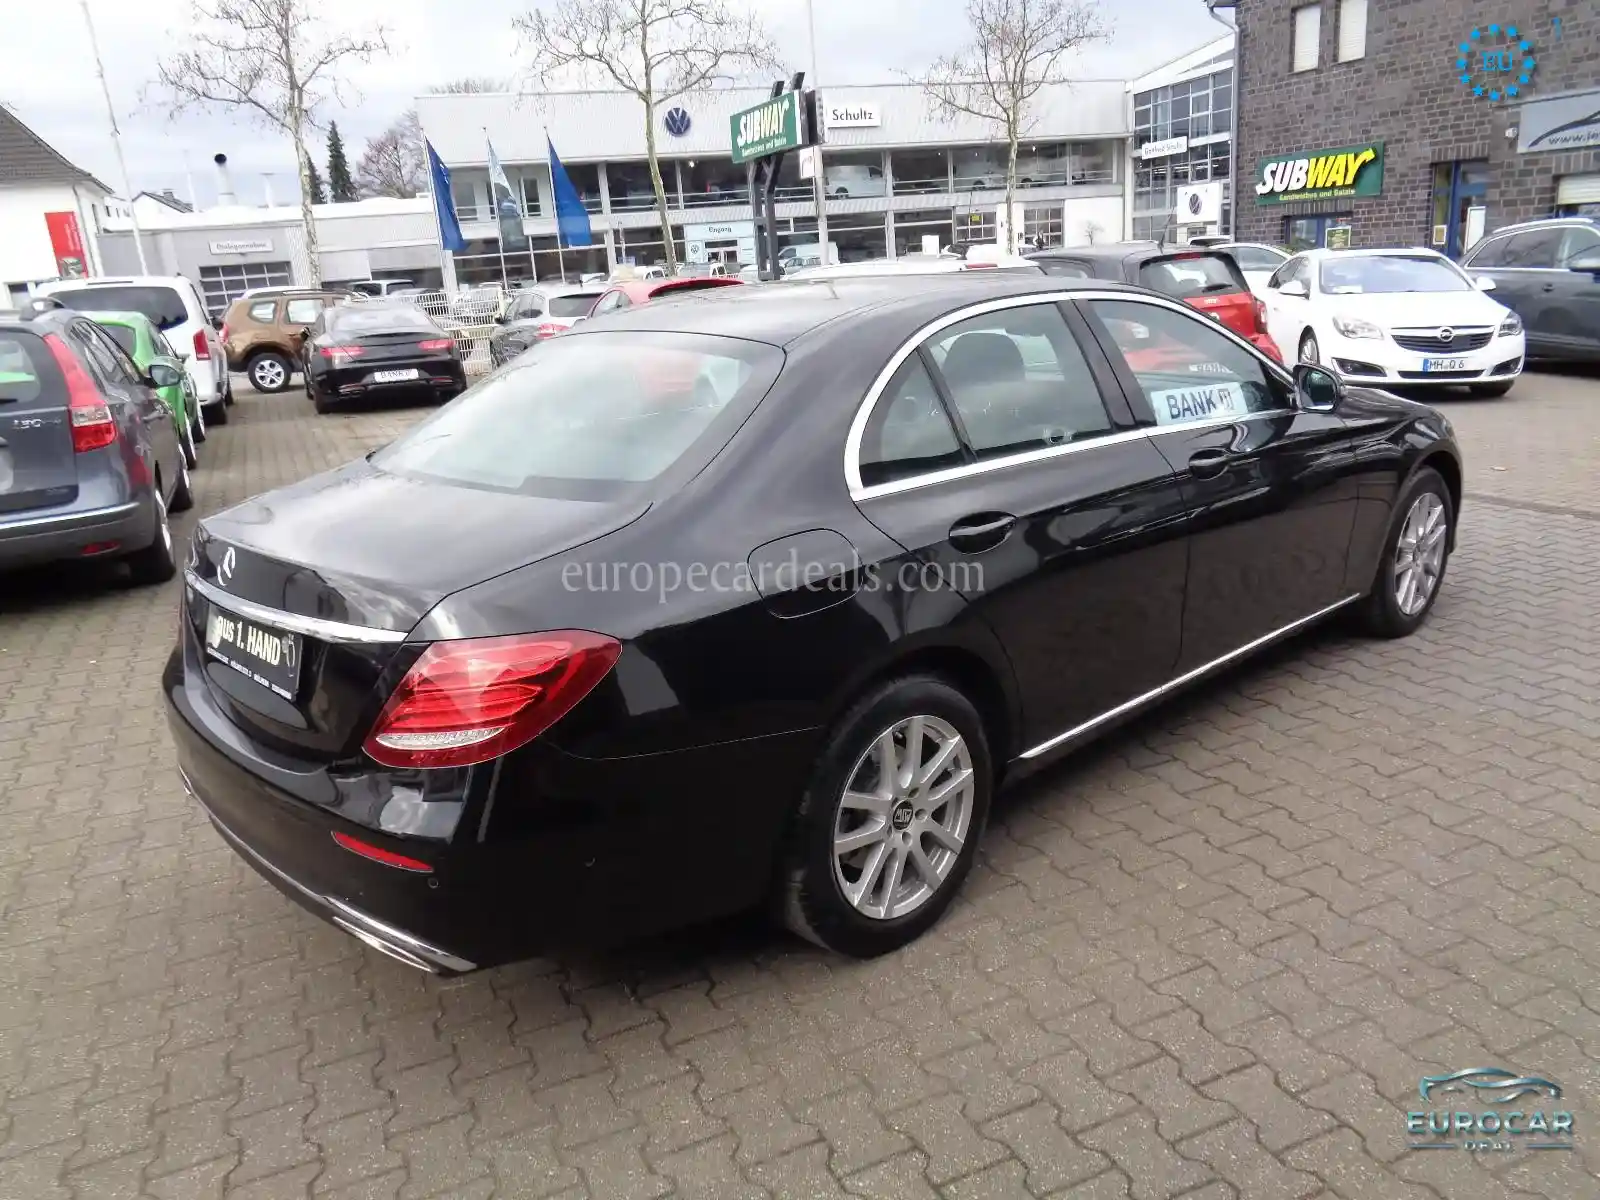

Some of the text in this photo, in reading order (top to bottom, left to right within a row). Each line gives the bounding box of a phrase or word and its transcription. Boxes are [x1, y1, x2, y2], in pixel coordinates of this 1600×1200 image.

[736, 98, 790, 148] SUBWAY
[832, 108, 874, 121] Schultz
[1255, 147, 1375, 195] SUBWAY
[1165, 389, 1217, 420] BANK
[246, 625, 281, 666] HAND
